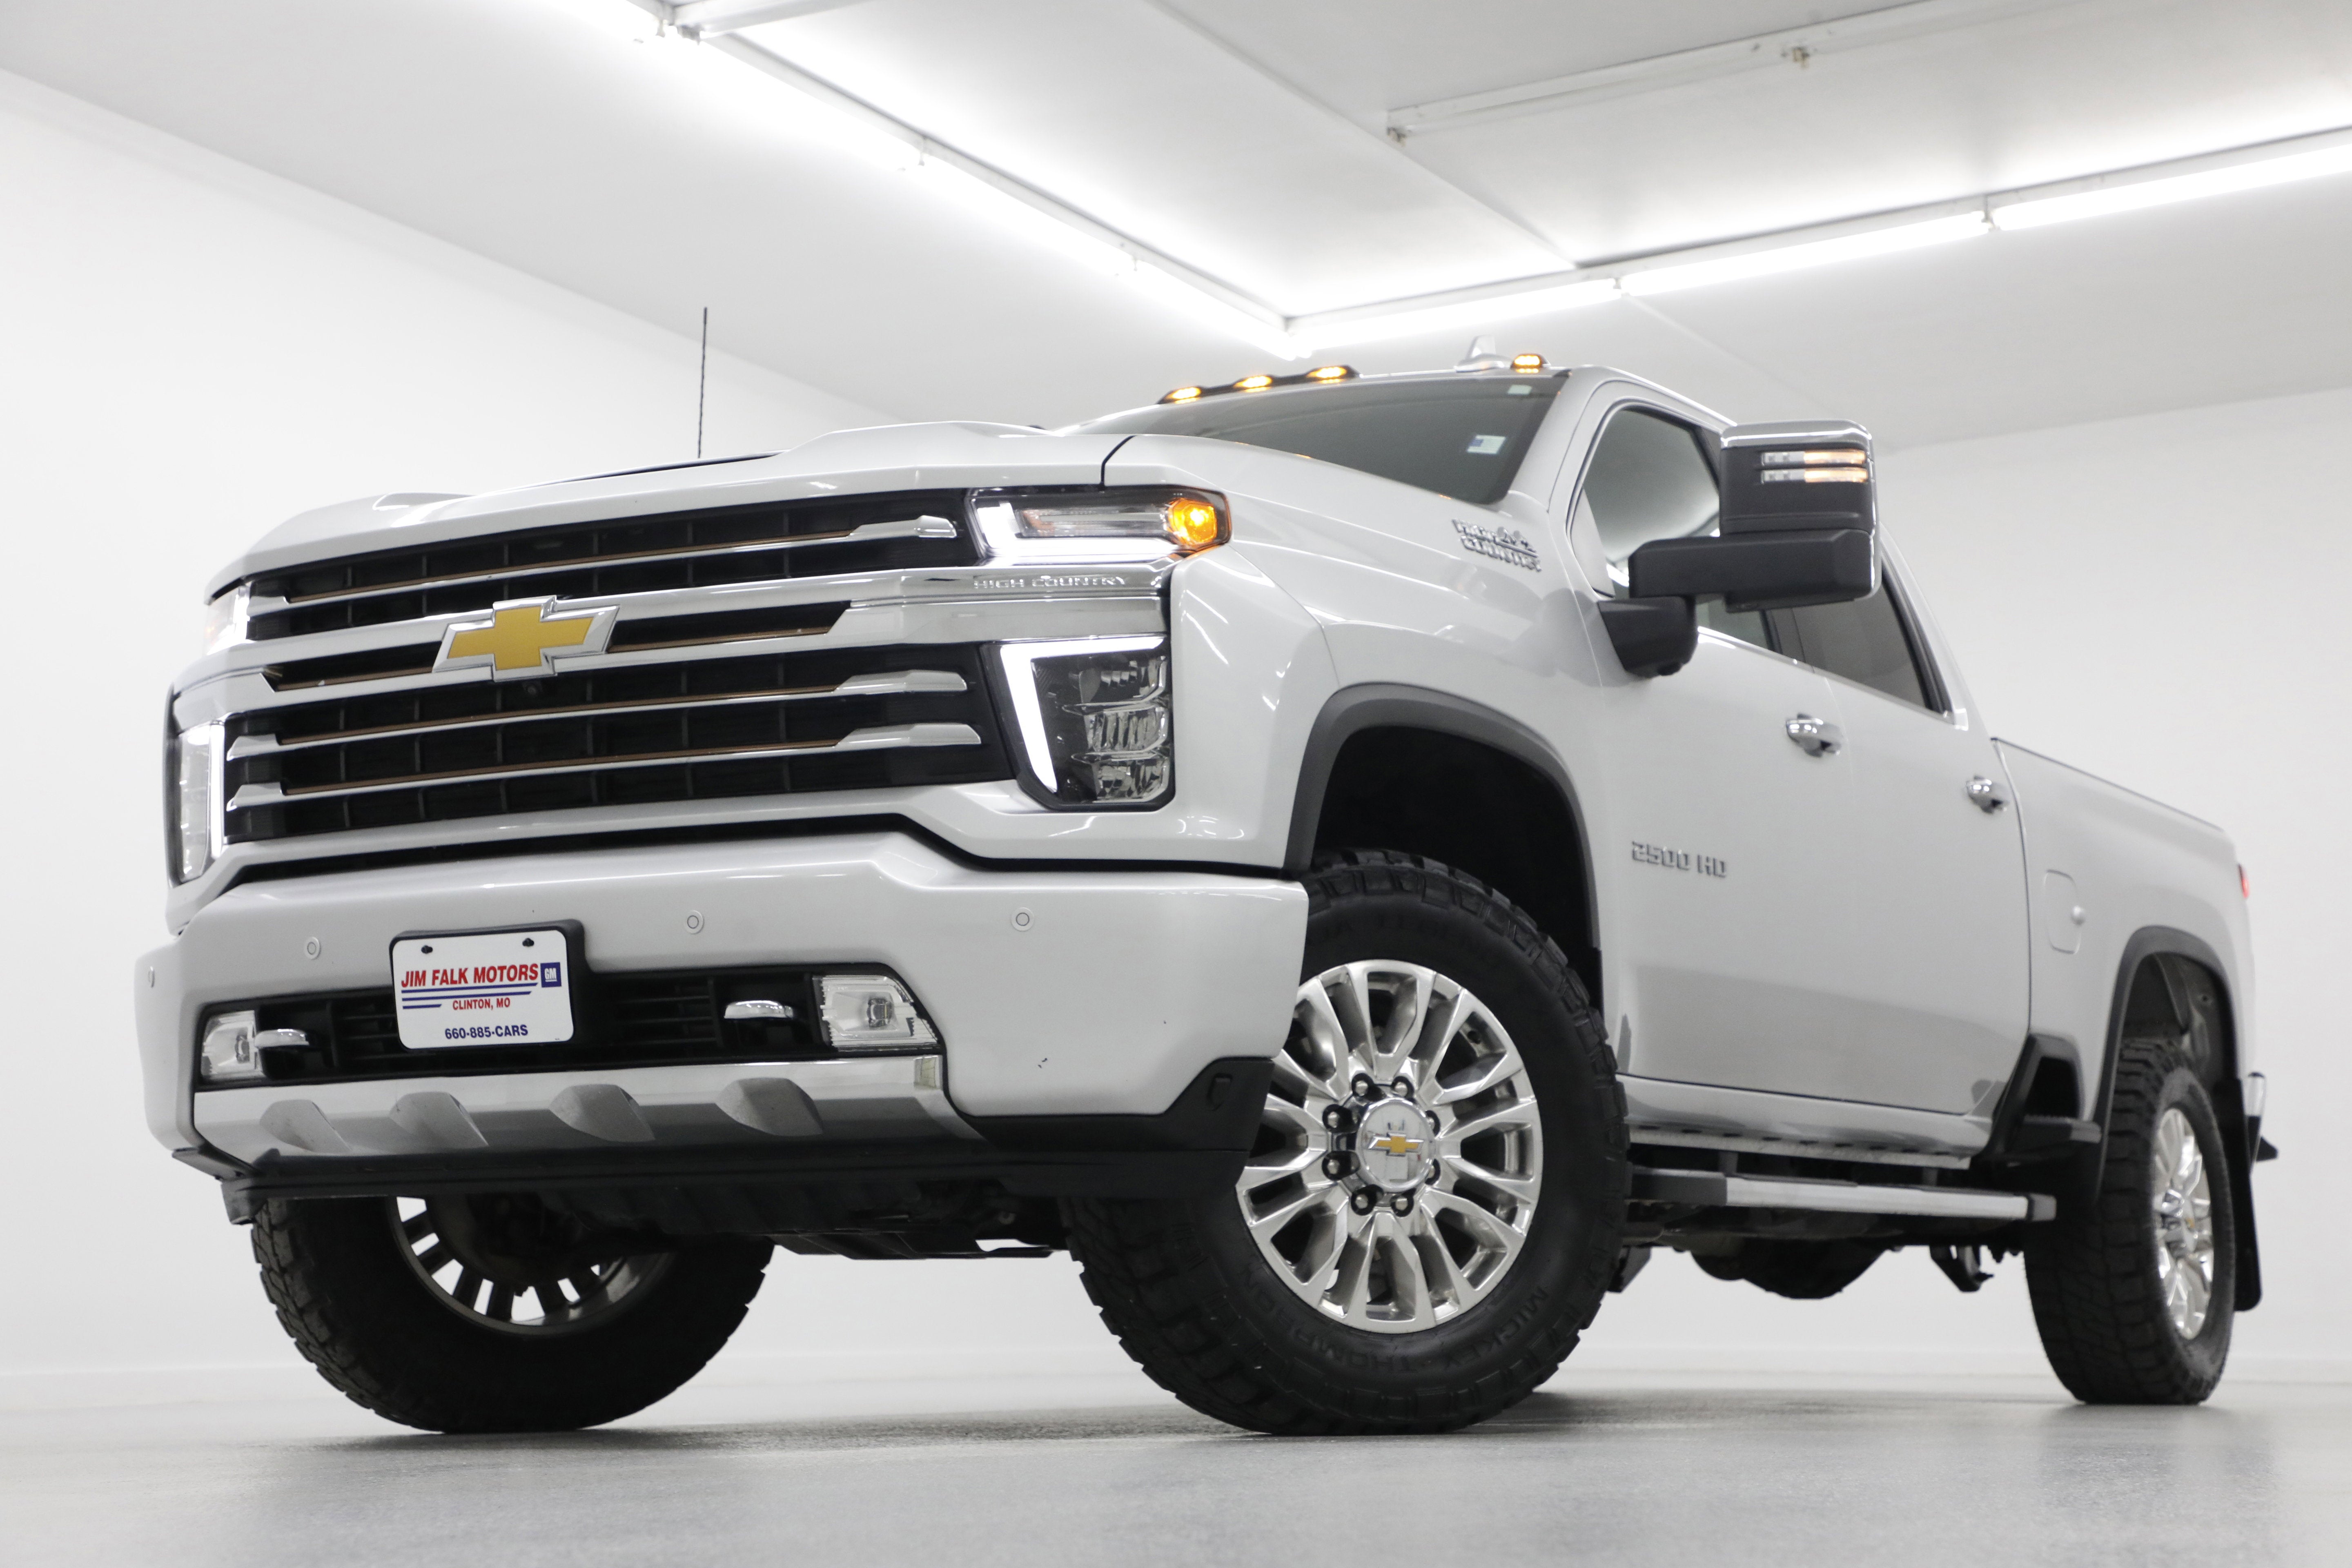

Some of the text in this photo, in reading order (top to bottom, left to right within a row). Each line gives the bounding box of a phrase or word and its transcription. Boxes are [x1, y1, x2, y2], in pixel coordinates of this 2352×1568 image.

[973, 576, 1125, 589] HIGH COUNTRY
[1632, 841, 1726, 878] 2500 HD
[401, 963, 539, 987] JIM FALK MOTORS
[544, 967, 557, 982] GM
[452, 997, 510, 1011] CLINTON, MO
[444, 1024, 528, 1039] 660-885-CARS
